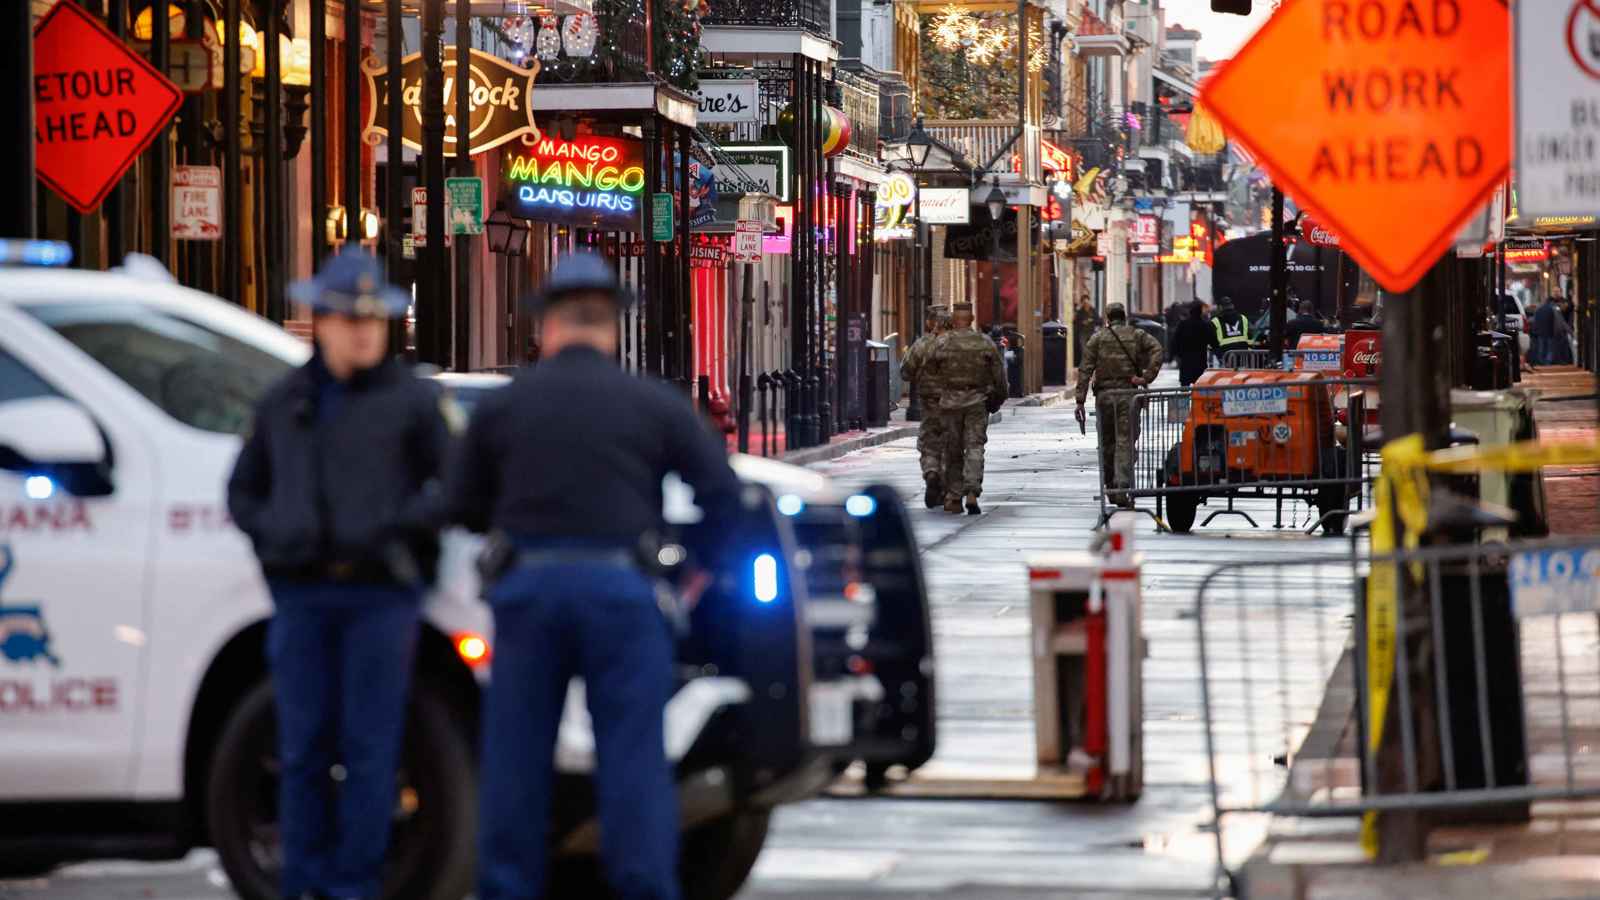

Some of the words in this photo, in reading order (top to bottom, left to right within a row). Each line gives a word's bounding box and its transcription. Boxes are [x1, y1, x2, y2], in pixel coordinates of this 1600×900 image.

[1322, 0, 1460, 41] ROAD
[34, 68, 136, 102] ETOUR
[1322, 66, 1463, 114] WORK
[538, 140, 618, 162] MANGO
[1309, 134, 1484, 184] AHEAD
[510, 156, 645, 192] MANGO
[519, 186, 634, 211] DAIQUIRIS
